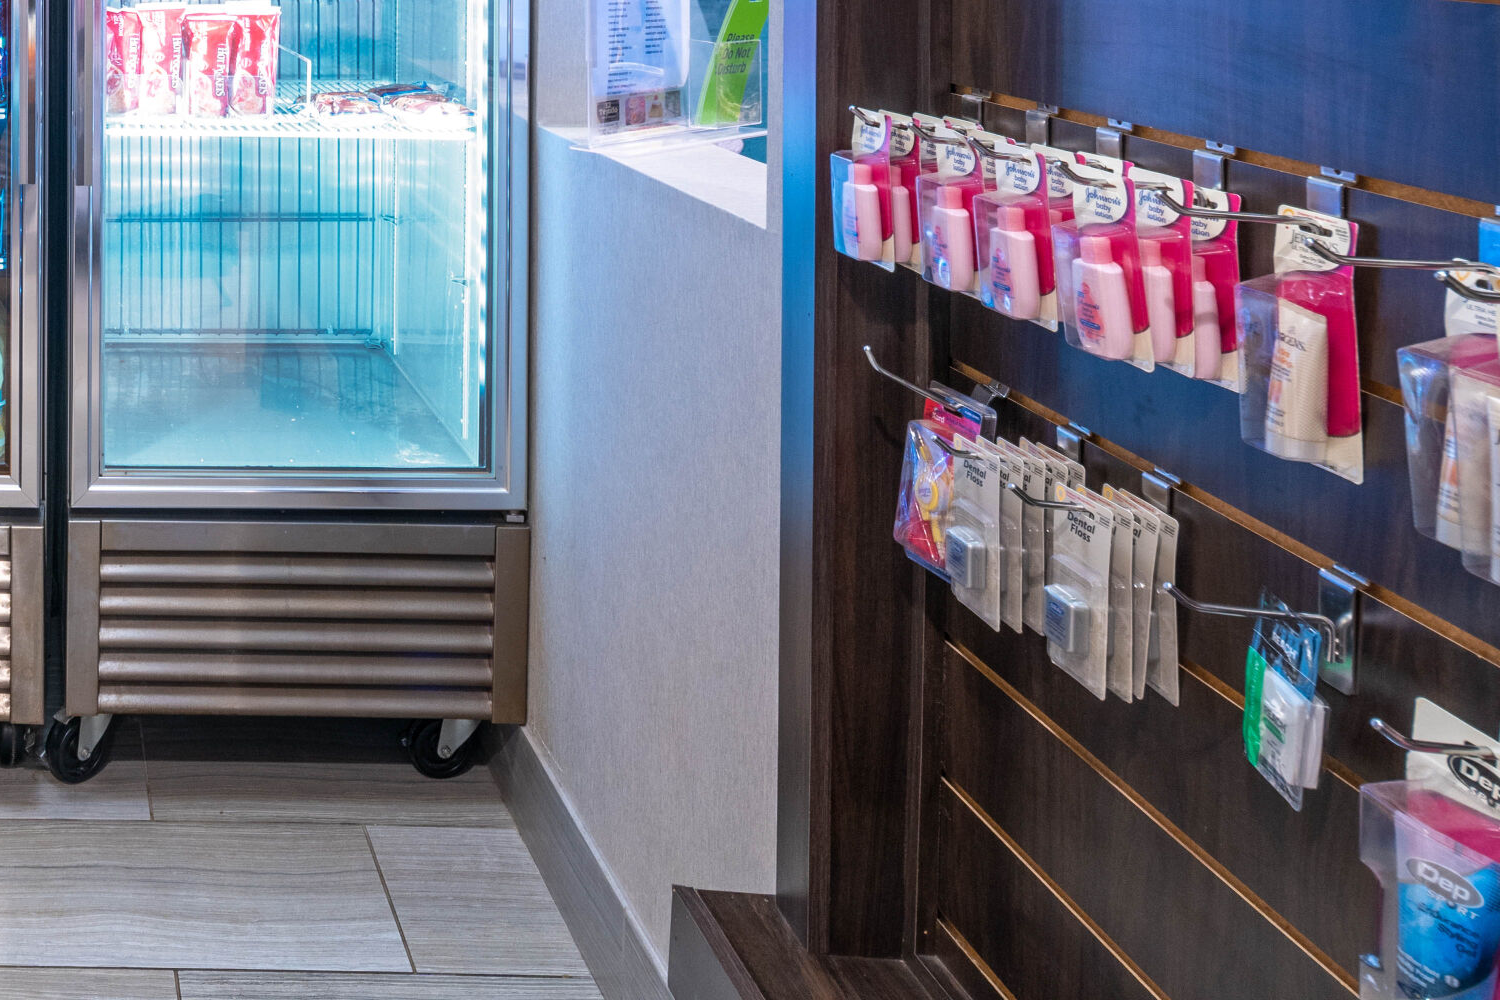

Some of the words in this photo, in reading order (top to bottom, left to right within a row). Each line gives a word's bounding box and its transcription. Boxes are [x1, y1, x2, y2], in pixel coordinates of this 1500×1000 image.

[734, 46, 751, 59] Not
[718, 62, 748, 76] Disturb
[945, 145, 972, 161] Johnson's
[1005, 161, 1036, 179] Johnson's
[1013, 182, 1029, 193] lotion
[1014, 175, 1028, 186] baby
[1051, 178, 1065, 189] baby
[1050, 184, 1067, 195] lotion
[1085, 187, 1122, 208] Johnson's
[1095, 202, 1112, 214] baby
[1148, 203, 1166, 216] baby
[1094, 209, 1114, 222] lotion
[1147, 211, 1168, 225] lotion
[963, 459, 988, 480] Dental
[966, 470, 983, 488] Floss
[1067, 511, 1096, 535] Dental
[1070, 523, 1091, 543] Floss
[1417, 861, 1470, 902] Dep
[1427, 889, 1481, 921] SPORT
